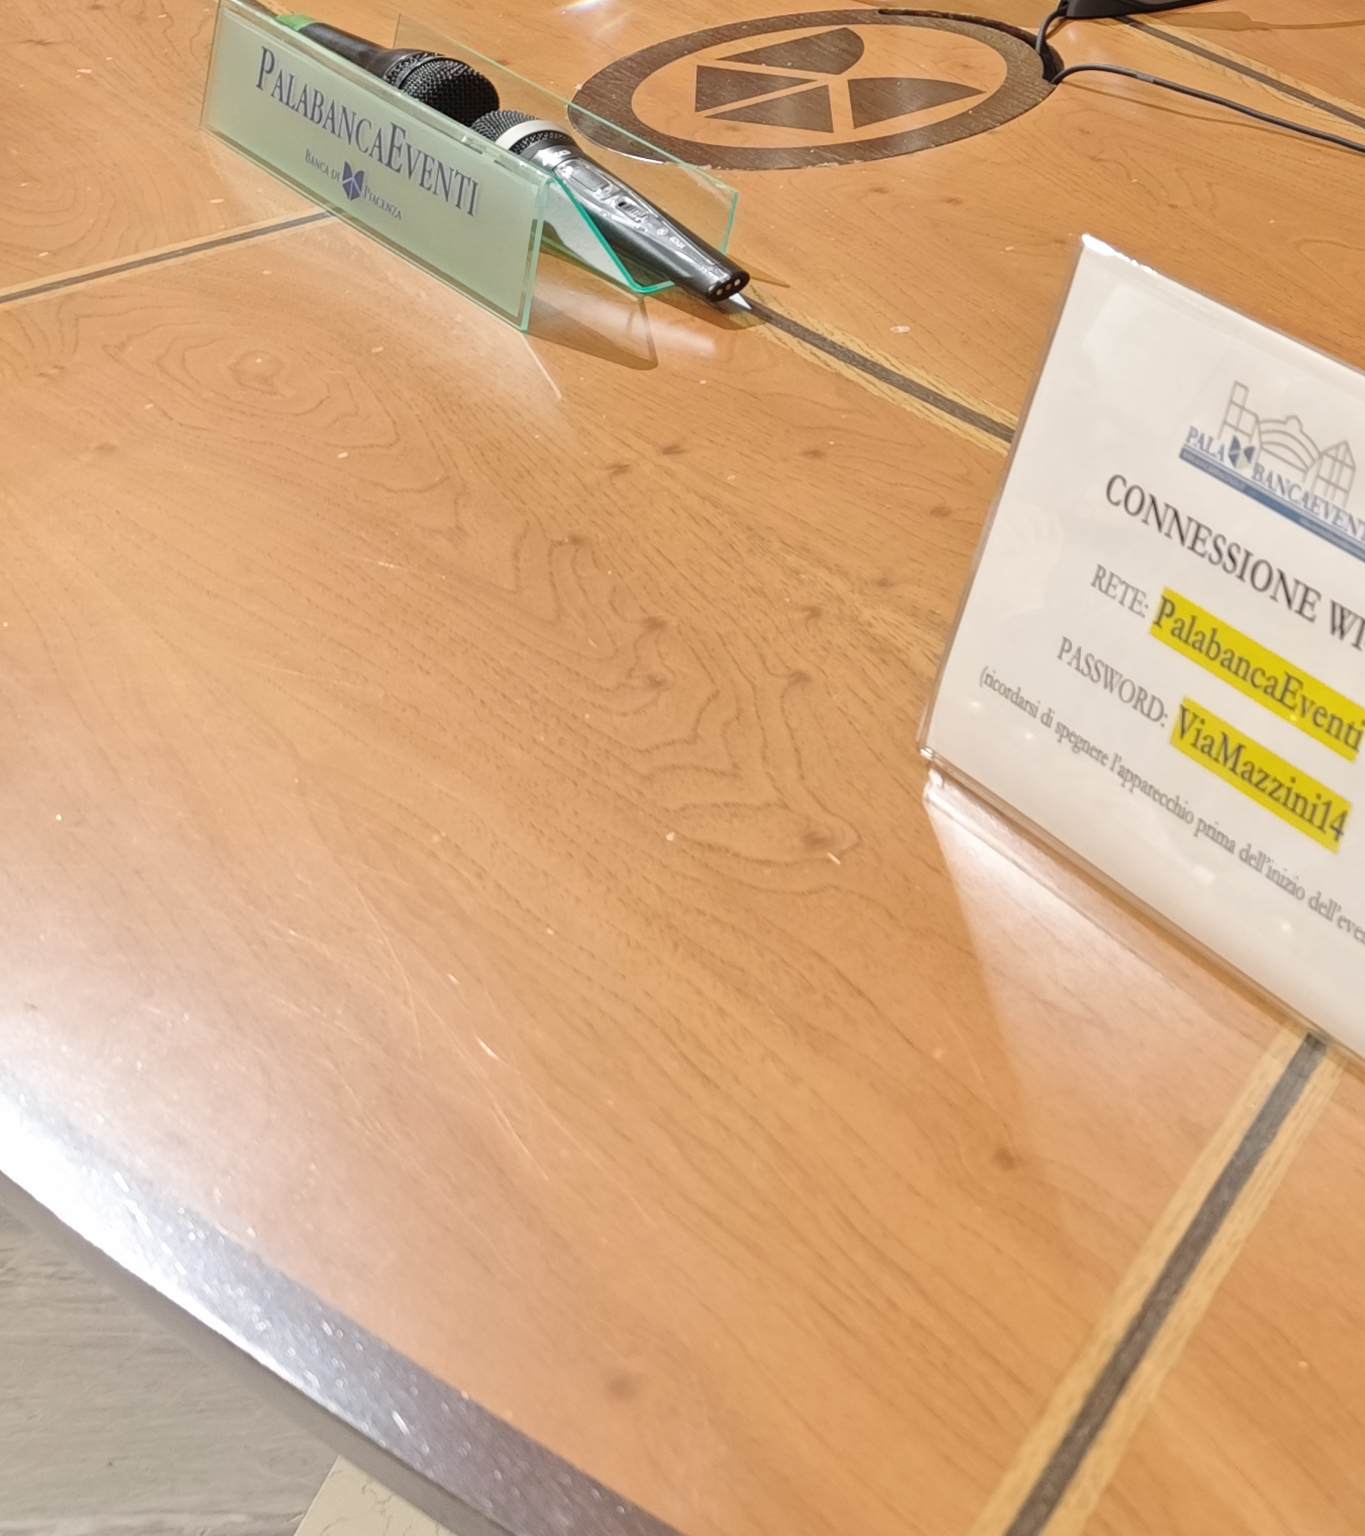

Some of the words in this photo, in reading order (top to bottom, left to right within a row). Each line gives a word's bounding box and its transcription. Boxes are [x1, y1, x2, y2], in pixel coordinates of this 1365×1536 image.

[1185, 426, 1226, 462] PALA
[1090, 564, 1150, 618] RETE:
[1105, 474, 1321, 623] CONNESSIONE
[979, 666, 1041, 719] (ricordarsi
[1040, 708, 1056, 728] di
[1054, 720, 1110, 766] spegnere
[1109, 752, 1195, 825] l'apparecchio
[1193, 817, 1236, 854] prima
[1238, 843, 1305, 902] dell'inizio
[1057, 636, 1168, 727] PASSWORD:
[1178, 703, 1349, 842] ViaMazzini14
